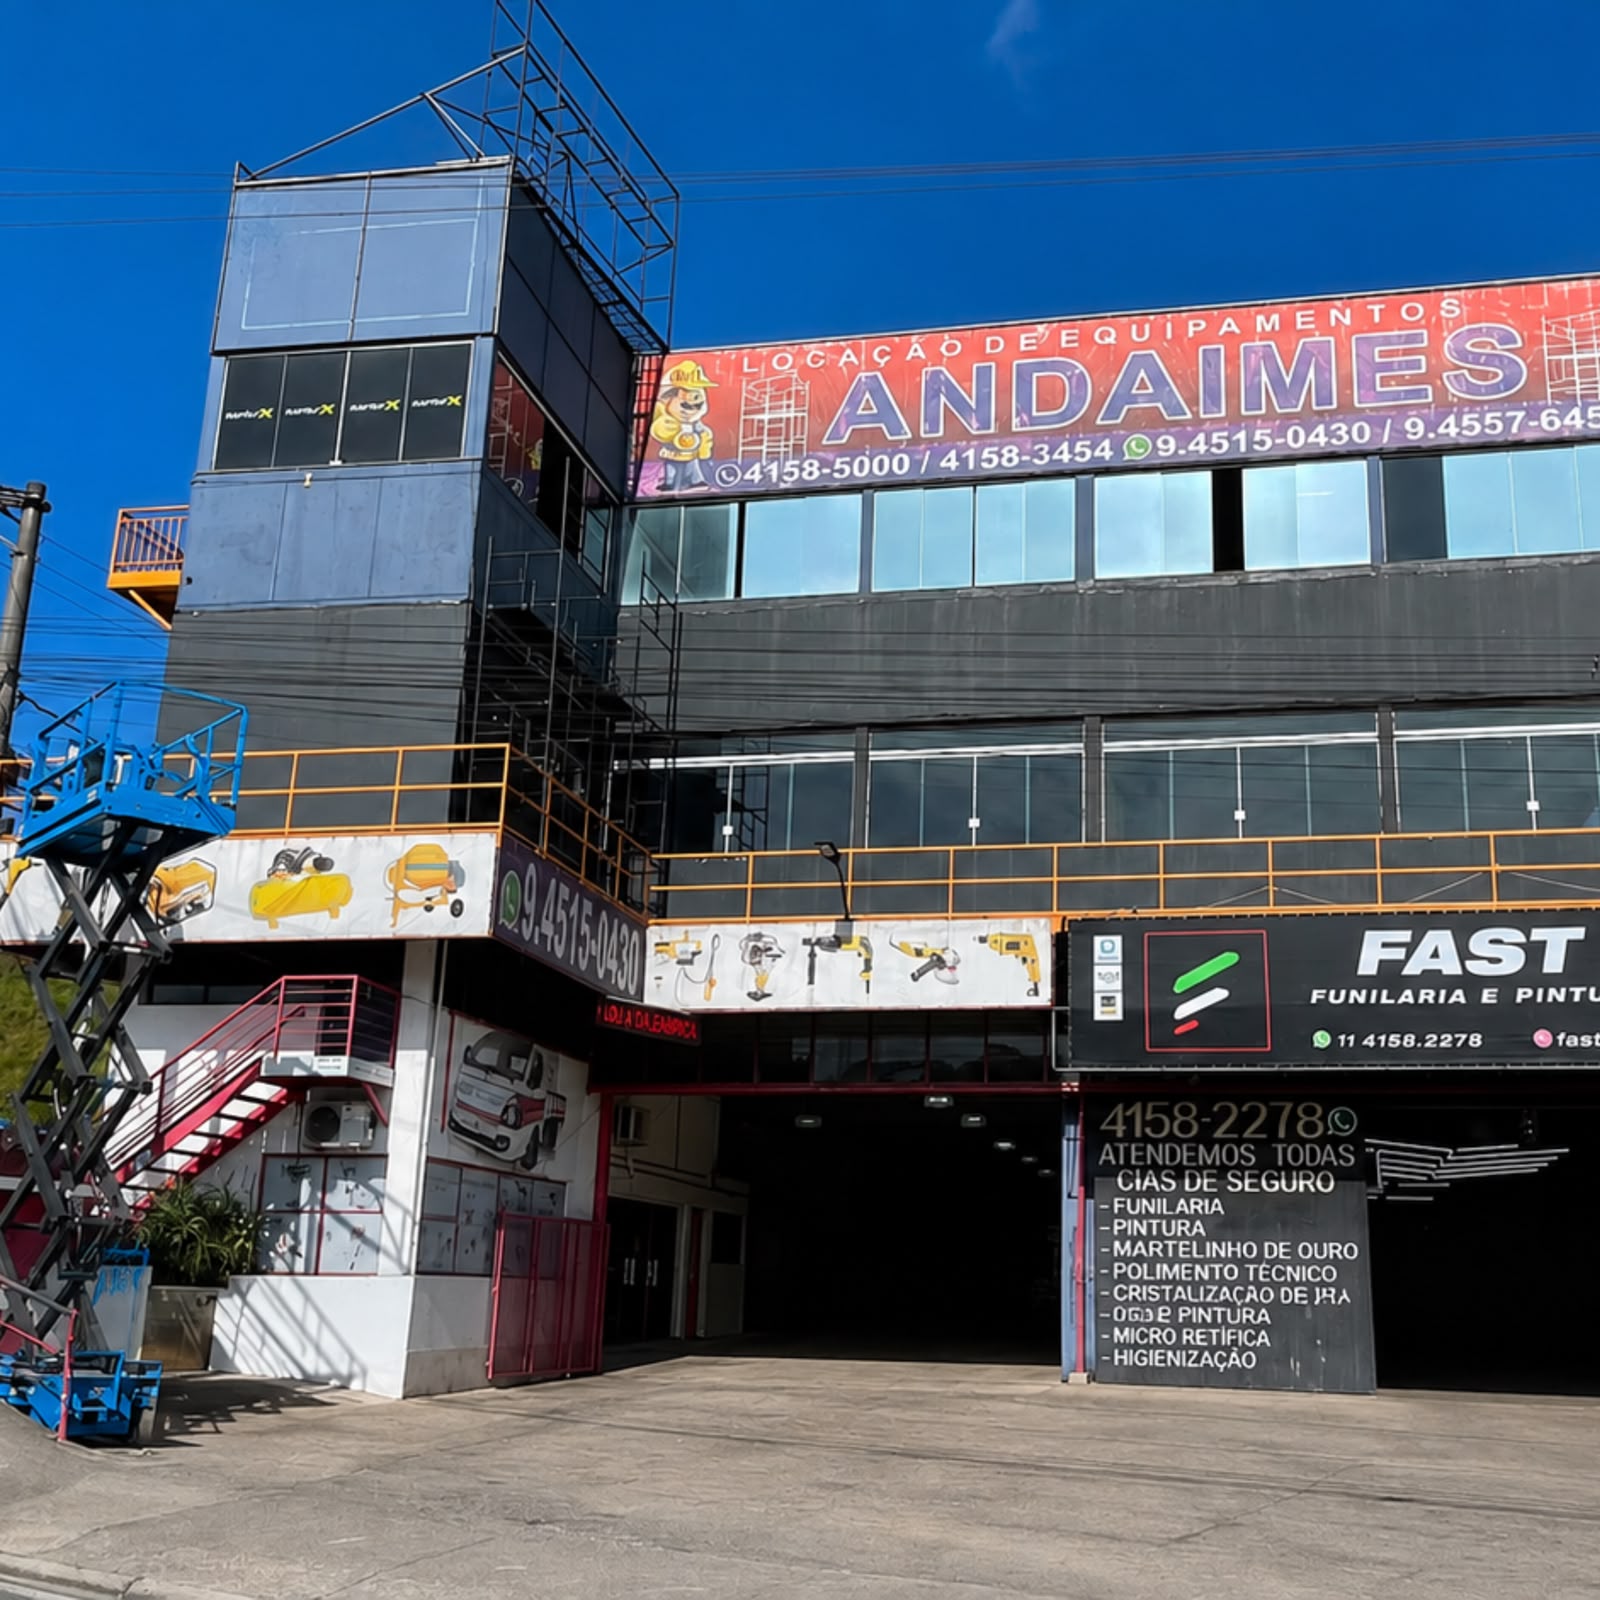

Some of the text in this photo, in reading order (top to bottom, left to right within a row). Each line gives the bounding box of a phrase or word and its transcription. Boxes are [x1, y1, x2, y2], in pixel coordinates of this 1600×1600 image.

[984, 332, 1038, 354] DE
[1060, 298, 1461, 348] EQUIPAMENTOS
[821, 323, 1528, 445] ANDAIMES
[742, 453, 911, 484] 4158-5000
[939, 437, 1114, 472] 4158-3454
[1156, 421, 1372, 456] 9.4515-0430
[521, 862, 641, 996] 9.4515-0430
[1356, 926, 1586, 977] FAST
[1310, 988, 1467, 1004] FUNILARIA
[1481, 988, 1499, 1003] E
[1337, 1033, 1483, 1048] 11 4158.2278
[1100, 1101, 1325, 1139] 4158-2278
[1099, 1143, 1355, 1167] ATENDEMOS TODAS
[1117, 1168, 1335, 1193] CIAS DE SEGURO
[1113, 1198, 1225, 1215] FUNILARIA
[1113, 1219, 1206, 1237] PINTURA
[1113, 1240, 1257, 1258] MARTELINHO
[1264, 1242, 1292, 1259] DE
[1298, 1242, 1359, 1260] OURO
[1113, 1263, 1239, 1280] POLIMENTO
[1245, 1260, 1338, 1282] TÉCNICO
[1280, 1287, 1308, 1304] DE
[1178, 1306, 1271, 1324] PINTURA
[1113, 1328, 1177, 1345] MICRO
[1113, 1348, 1256, 1372] HIGIENIZAÇÃO
